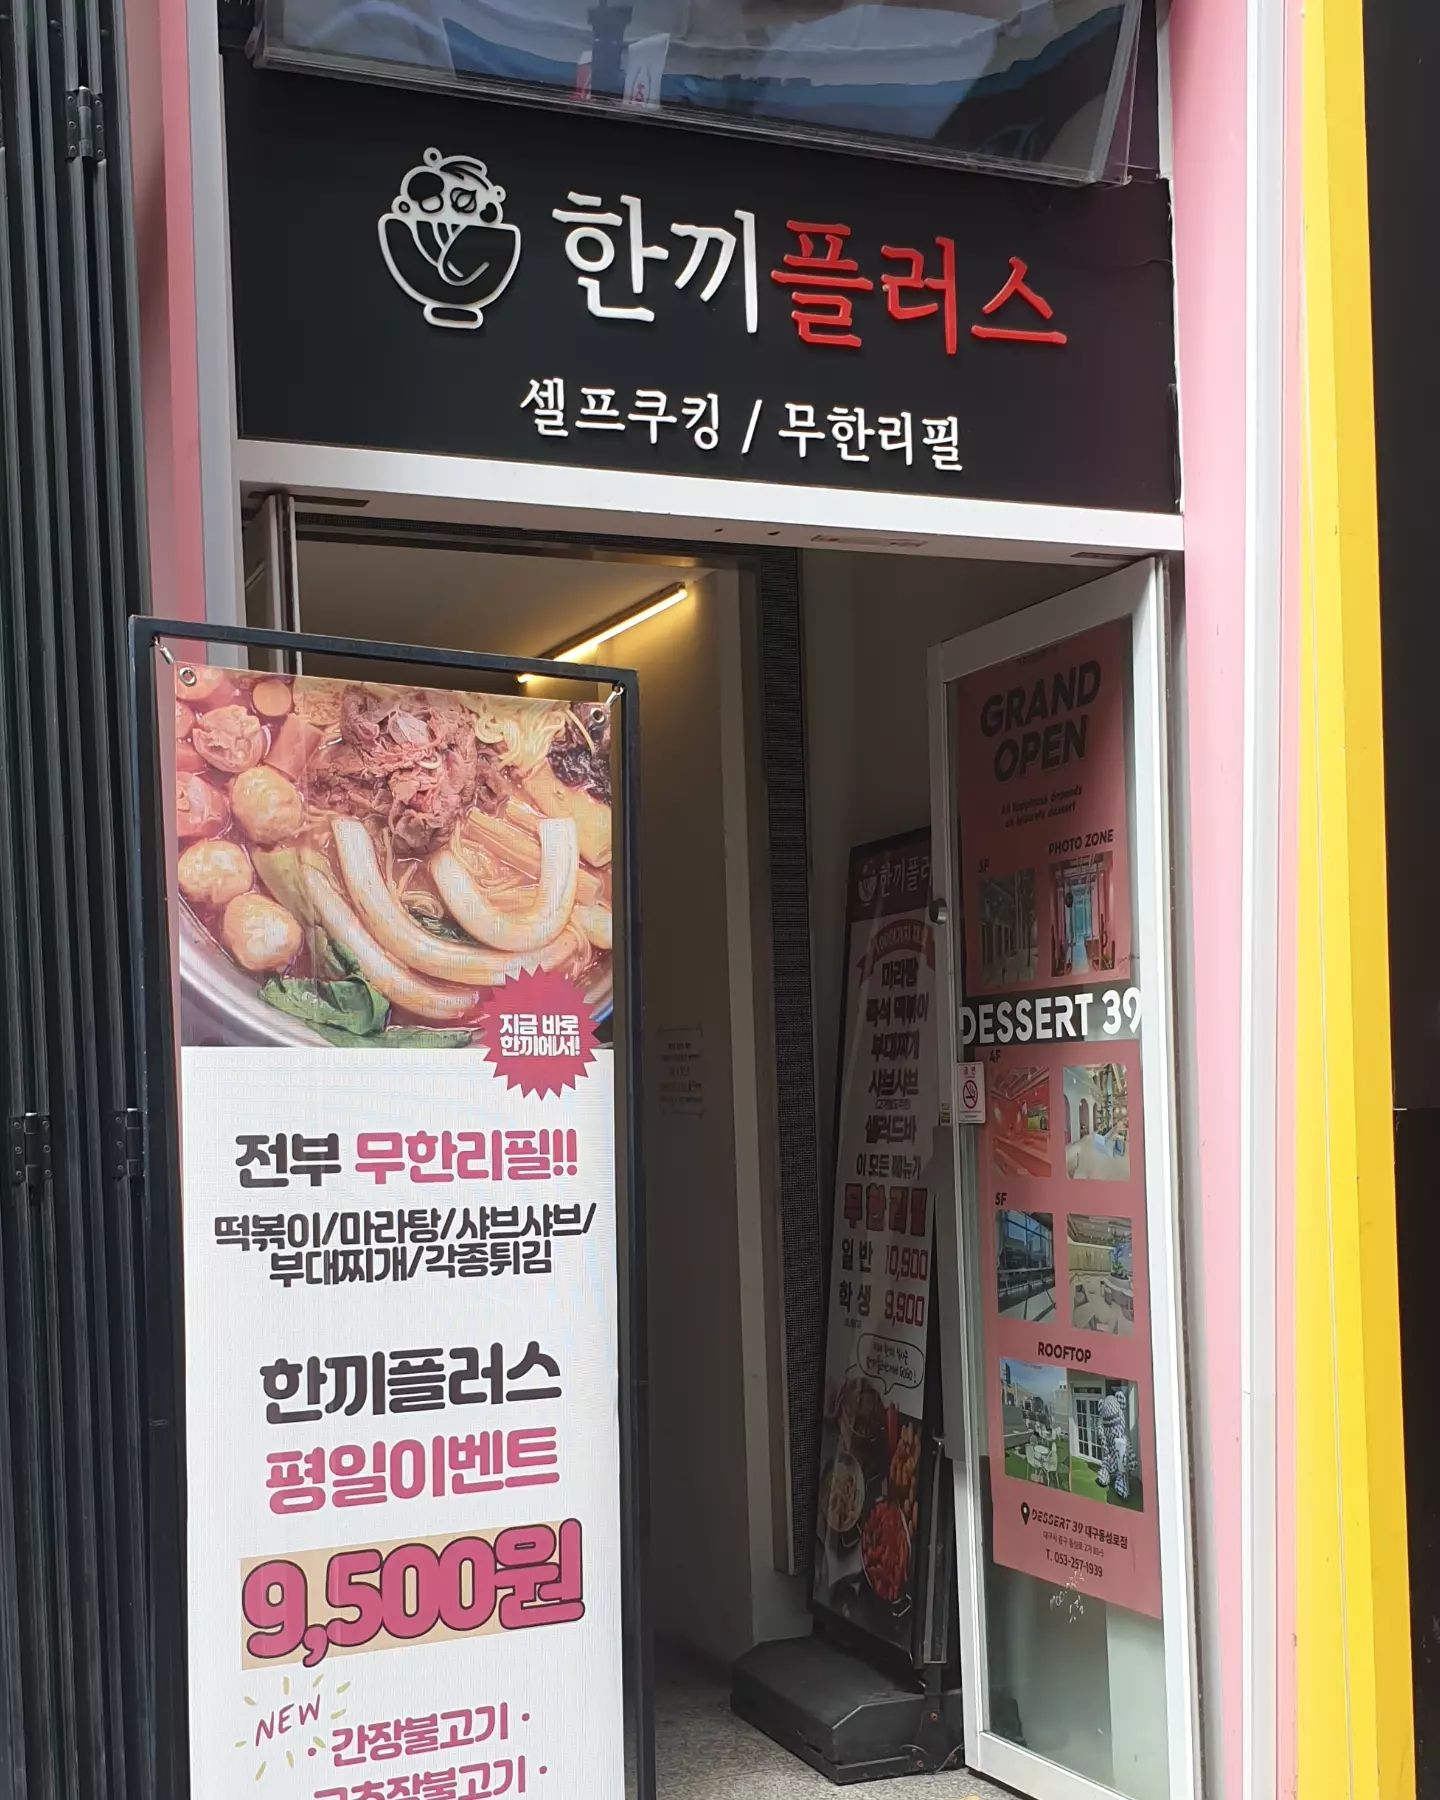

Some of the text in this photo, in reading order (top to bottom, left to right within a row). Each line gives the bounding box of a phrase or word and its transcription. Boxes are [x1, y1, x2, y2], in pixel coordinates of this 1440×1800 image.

[551, 190, 1068, 354] 한끼플러스
[520, 377, 721, 450] 셀프쿠킹
[778, 402, 964, 472] 무한리필
[980, 659, 1101, 737] GRAND
[994, 714, 1088, 782] OPEN
[1048, 828, 1114, 857] PHOTO ZONE
[499, 1013, 580, 1035] 지금 바로
[959, 986, 1142, 1045] DESSERT 39
[499, 1035, 581, 1057] 한끼에서!
[235, 1128, 579, 1189] 전부 무한리필!!
[884, 1289, 925, 1327] 9,900
[259, 1340, 563, 1425] 한끼플러스
[1037, 1341, 1092, 1364] ROOFTOP
[265, 1426, 561, 1515] 평일이벤트
[1031, 1508, 1128, 1550] DESSERT 39 대구동성로점
[241, 1517, 586, 1668] 9,500원
[1054, 1551, 1103, 1578] 053-257-1939
[254, 1693, 322, 1747] NEW
[330, 1702, 509, 1768] 간장불고기
